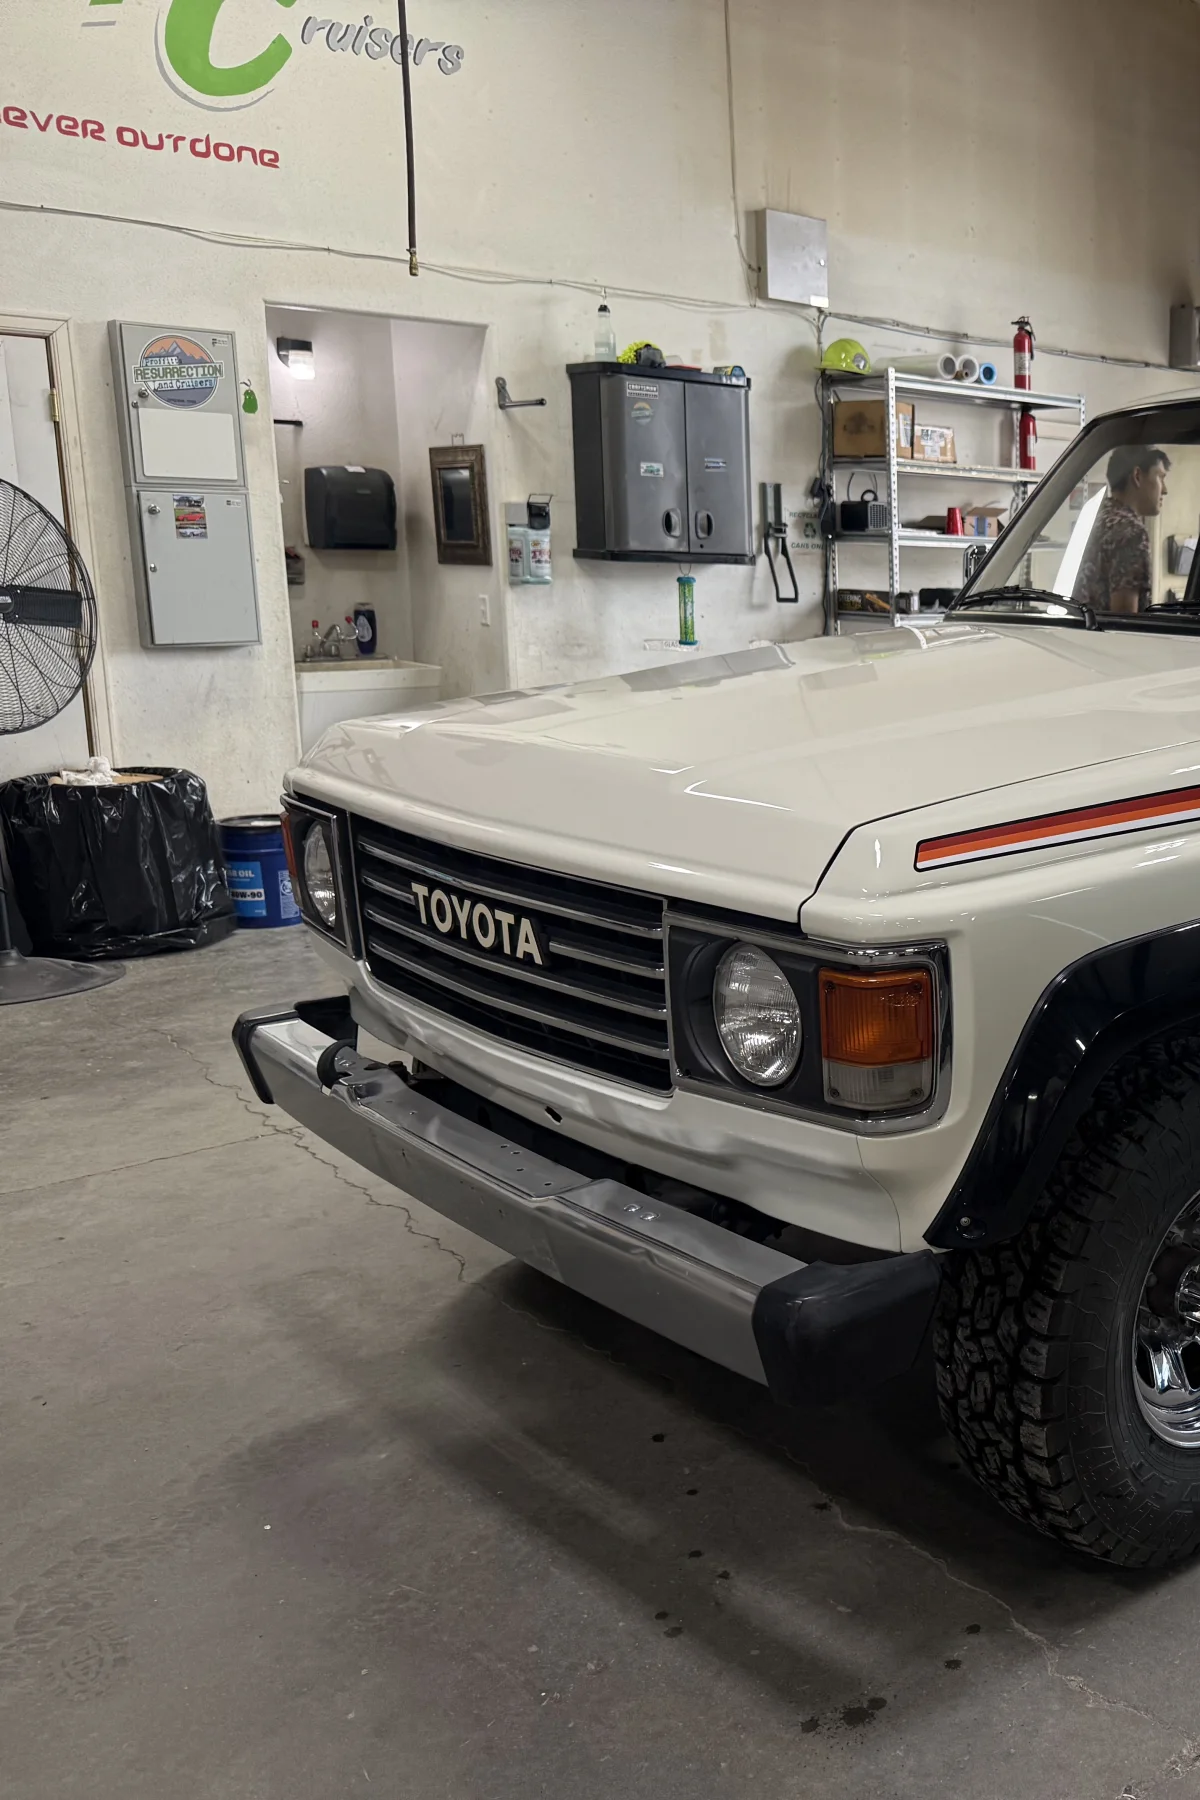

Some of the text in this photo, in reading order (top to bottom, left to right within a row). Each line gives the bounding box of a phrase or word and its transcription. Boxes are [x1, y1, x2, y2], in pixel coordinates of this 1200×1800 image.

[134, 364, 221, 380] RESURRECTION
[175, 379, 213, 389] Cruisers
[238, 870, 255, 878] OIL
[411, 882, 543, 965] TOYOTA
